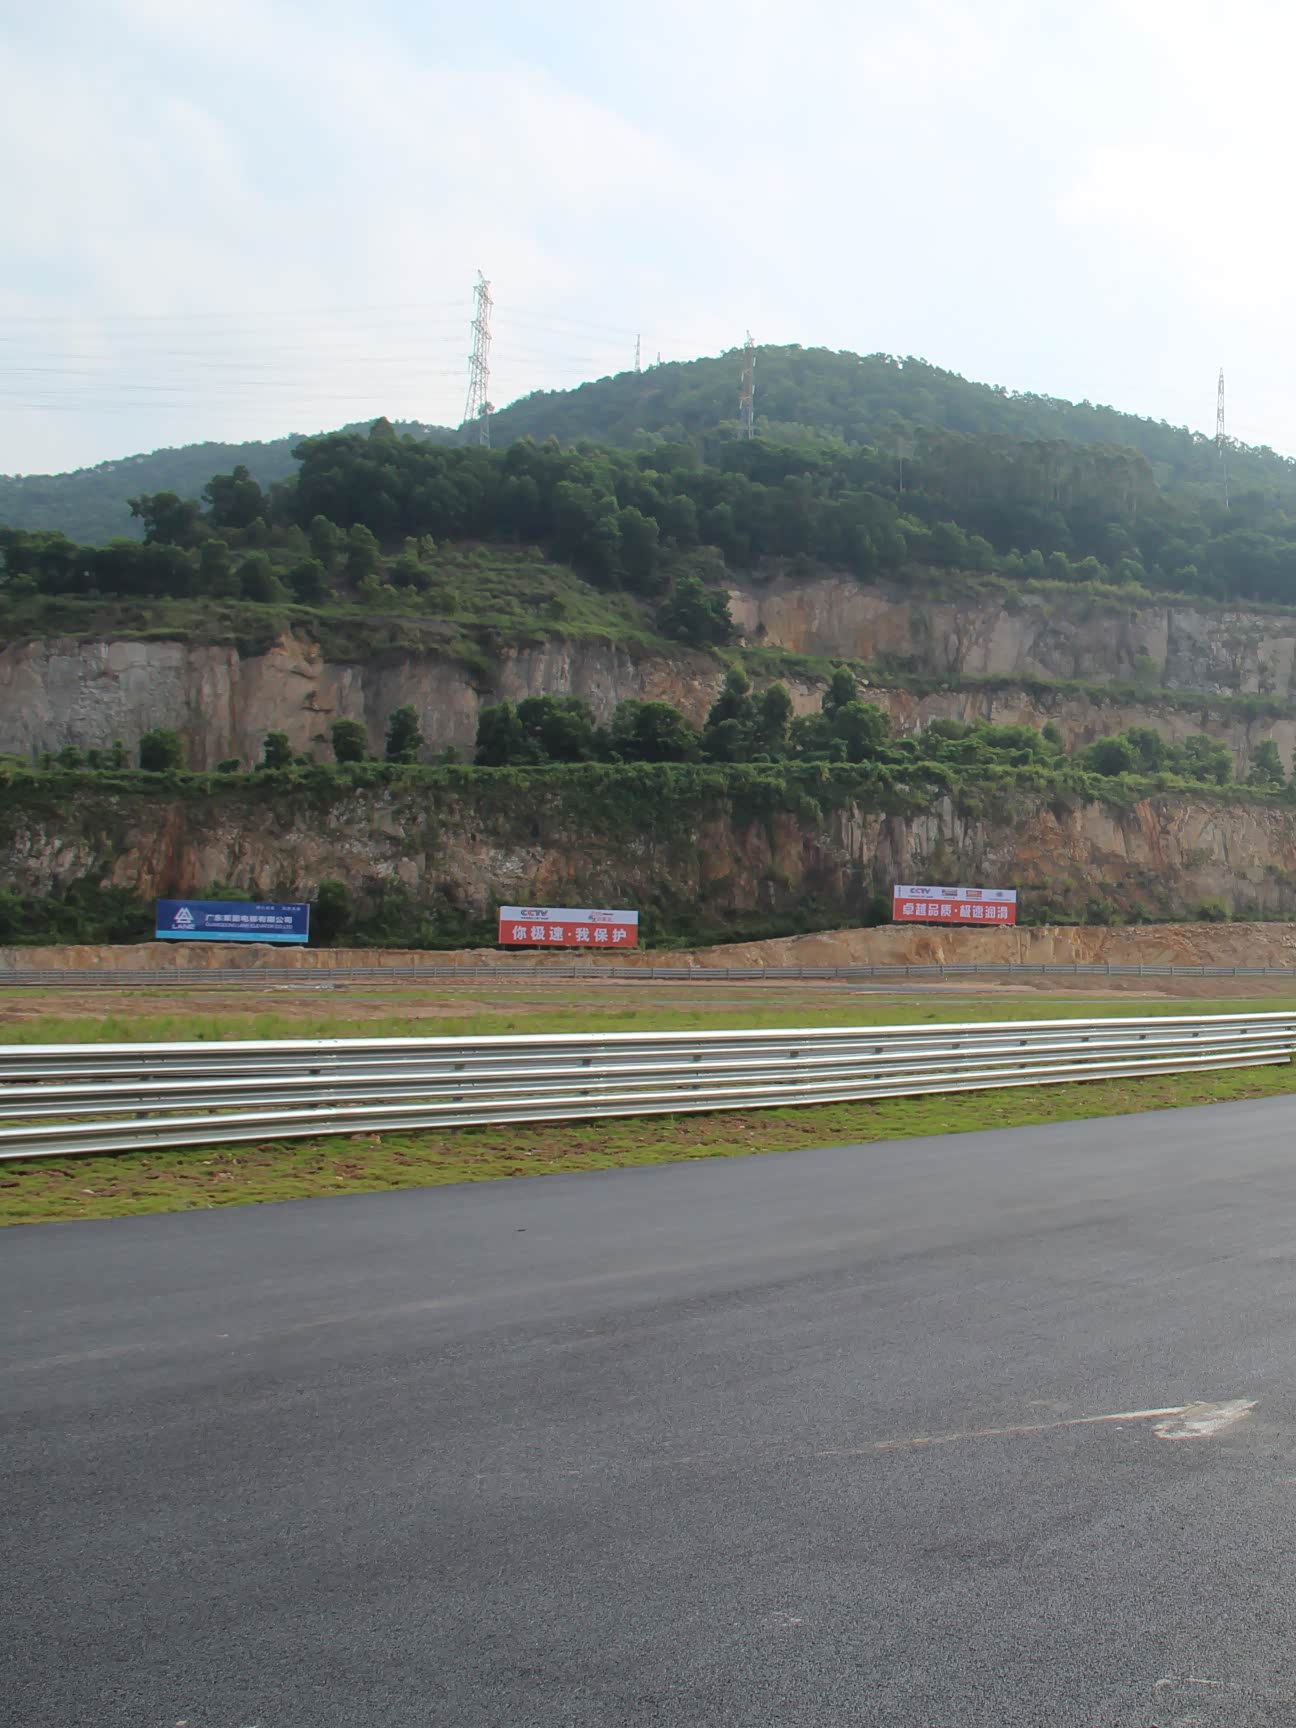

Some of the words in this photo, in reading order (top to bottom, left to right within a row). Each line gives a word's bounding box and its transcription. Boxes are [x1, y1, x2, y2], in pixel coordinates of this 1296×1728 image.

[520, 909, 549, 917] CCTV
[512, 925, 626, 942] 你极速·我保护
